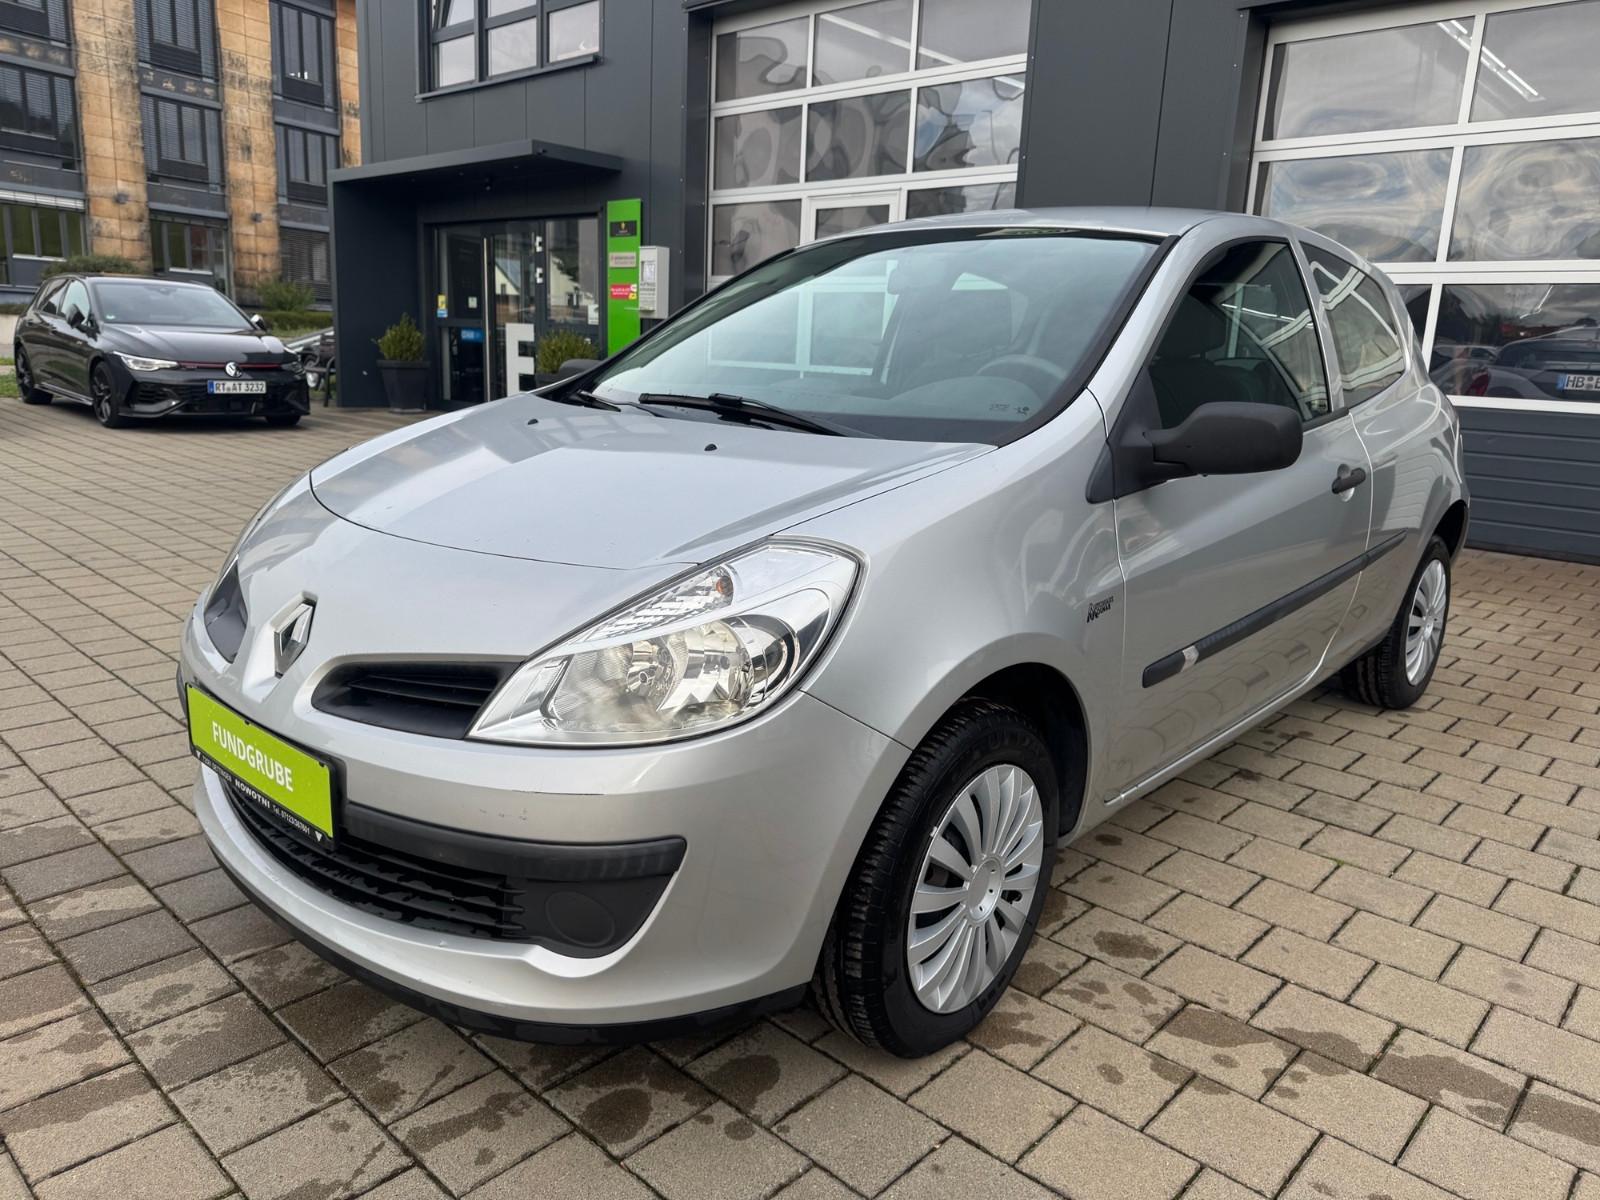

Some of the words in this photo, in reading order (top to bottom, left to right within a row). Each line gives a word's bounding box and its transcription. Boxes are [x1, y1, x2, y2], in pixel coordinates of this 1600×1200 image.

[215, 382, 226, 392] RT
[231, 382, 242, 392] AT
[244, 382, 264, 392] 3232
[1566, 375, 1586, 388] HB
[212, 720, 294, 792] FUNDGRUBE
